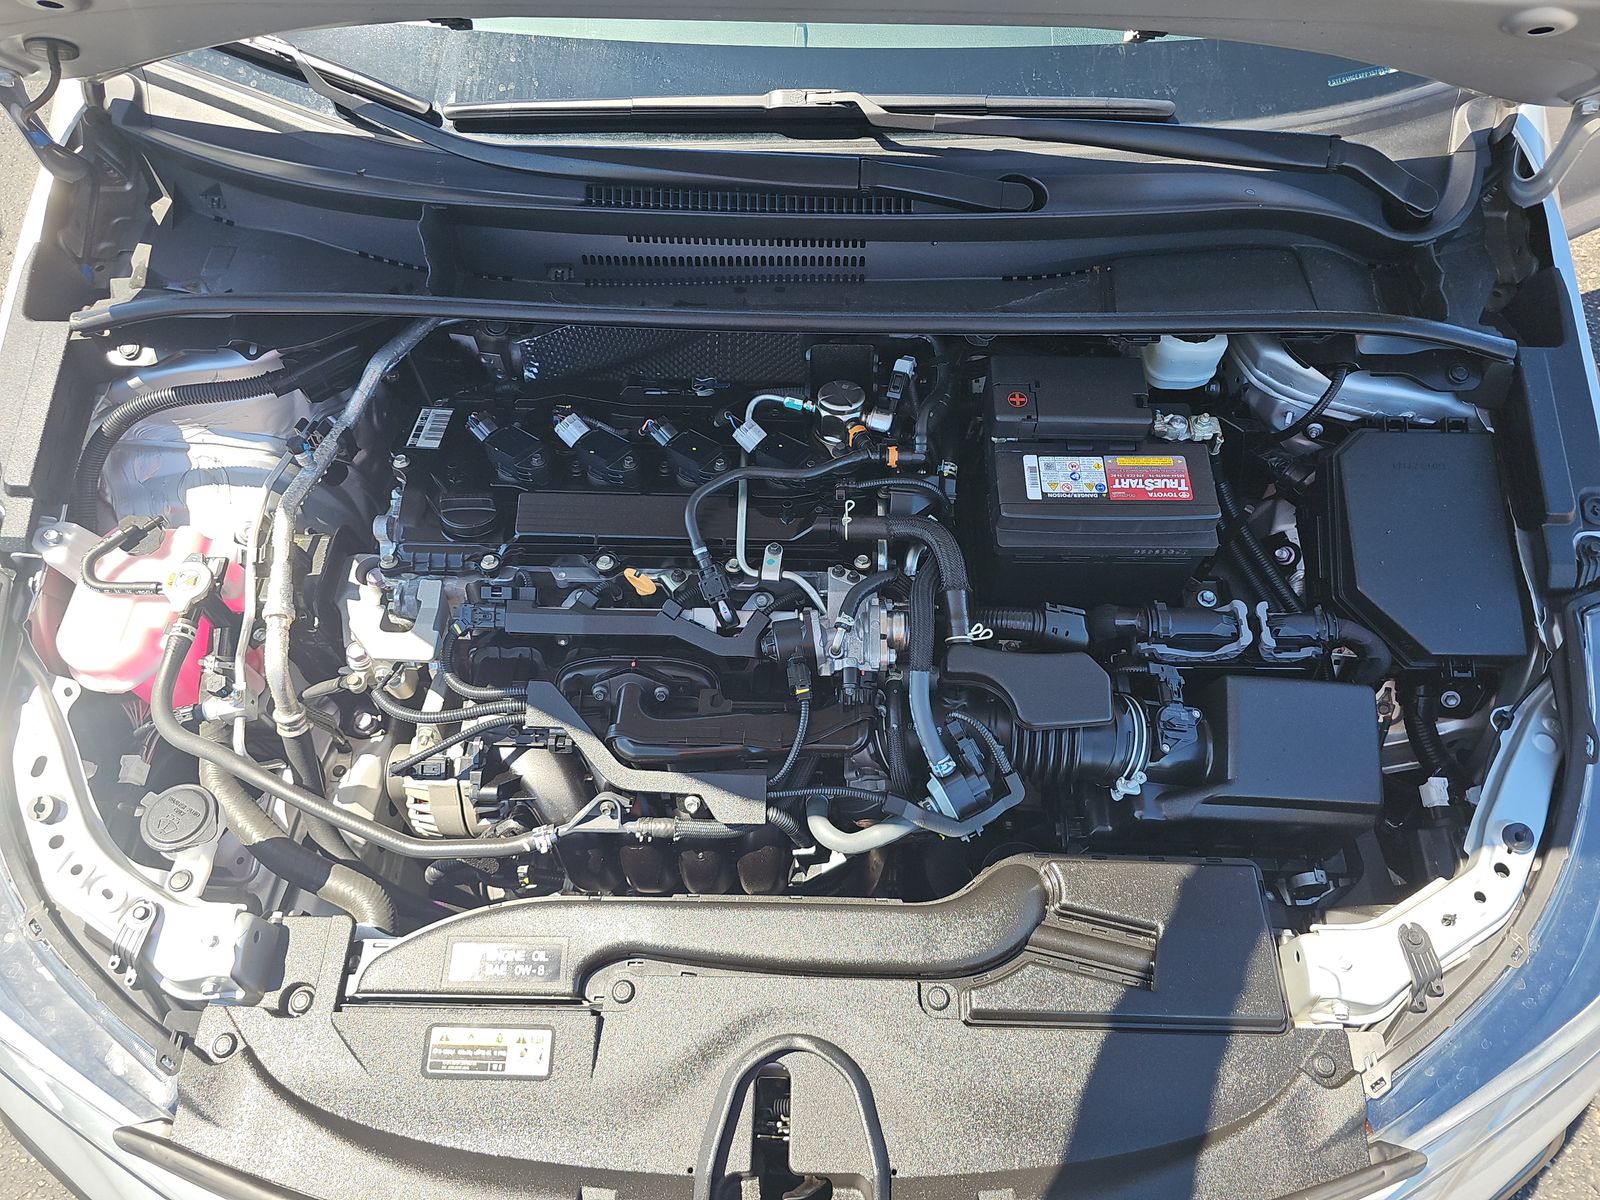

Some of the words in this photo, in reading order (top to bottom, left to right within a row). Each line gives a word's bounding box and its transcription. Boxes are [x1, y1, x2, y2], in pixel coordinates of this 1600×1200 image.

[1113, 478, 1189, 491] TRUESTART
[531, 950, 549, 962] OIL
[514, 965, 545, 976] 0W-8
